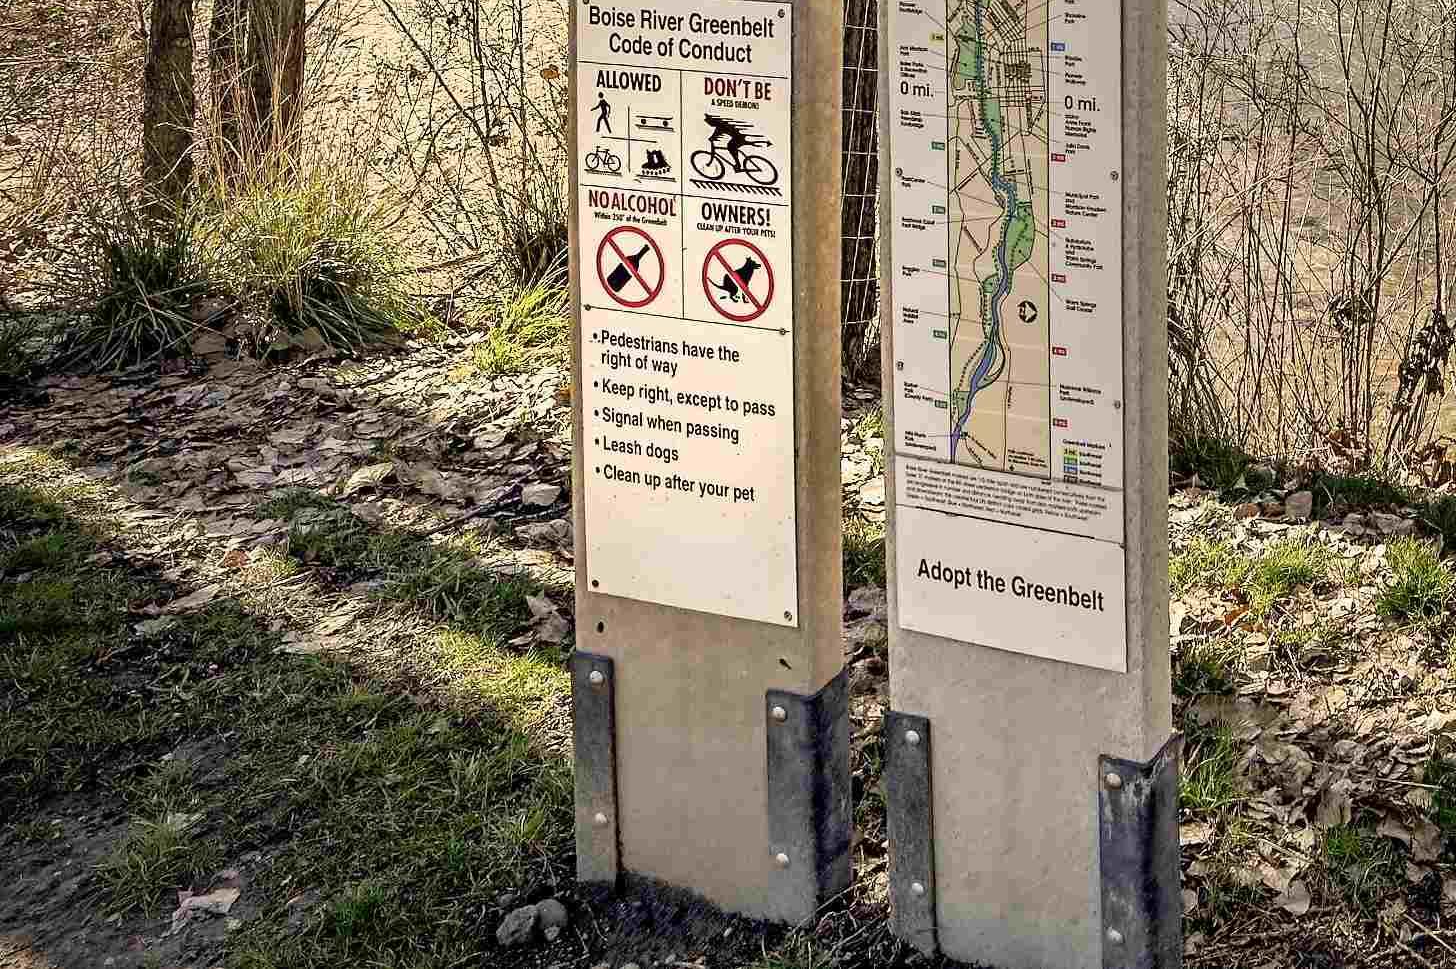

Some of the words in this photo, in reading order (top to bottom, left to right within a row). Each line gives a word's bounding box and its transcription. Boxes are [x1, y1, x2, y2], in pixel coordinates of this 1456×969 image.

[590, 6, 635, 27] Boise
[641, 9, 684, 31] River
[689, 13, 774, 38] Greenbelt
[609, 33, 651, 55] Code
[657, 37, 674, 57] of
[679, 39, 752, 63] Conduct
[596, 70, 662, 92] ALLOWED
[704, 77, 752, 99] DON'T
[755, 82, 772, 100] BE
[900, 81, 908, 95] 0
[913, 83, 934, 97] mi.
[1064, 95, 1072, 109] 0
[1078, 97, 1100, 111] mi.
[588, 189, 609, 209] NO
[612, 193, 676, 217] ALCOHOL
[702, 202, 770, 227] OWNERS!
[602, 330, 678, 355] Pedestrians
[682, 341, 714, 359] have
[718, 345, 740, 362] the
[602, 352, 631, 369] right
[636, 355, 648, 369] of
[652, 360, 678, 377] way
[602, 379, 634, 399] Keep
[639, 384, 672, 405] right,
[677, 391, 722, 411] except
[726, 396, 738, 411] to
[743, 401, 776, 417] pass
[602, 407, 642, 427] Signal
[647, 415, 682, 433] when
[686, 421, 739, 444] passing
[604, 435, 642, 455] Leash
[646, 443, 679, 463] dogs
[604, 465, 640, 483] Clean
[645, 473, 661, 489] up
[665, 475, 694, 491] after
[700, 482, 728, 497] your
[734, 486, 755, 503] pet
[918, 559, 972, 588] Adopt
[977, 571, 1006, 593] the
[1012, 576, 1104, 611] Greenbelt
